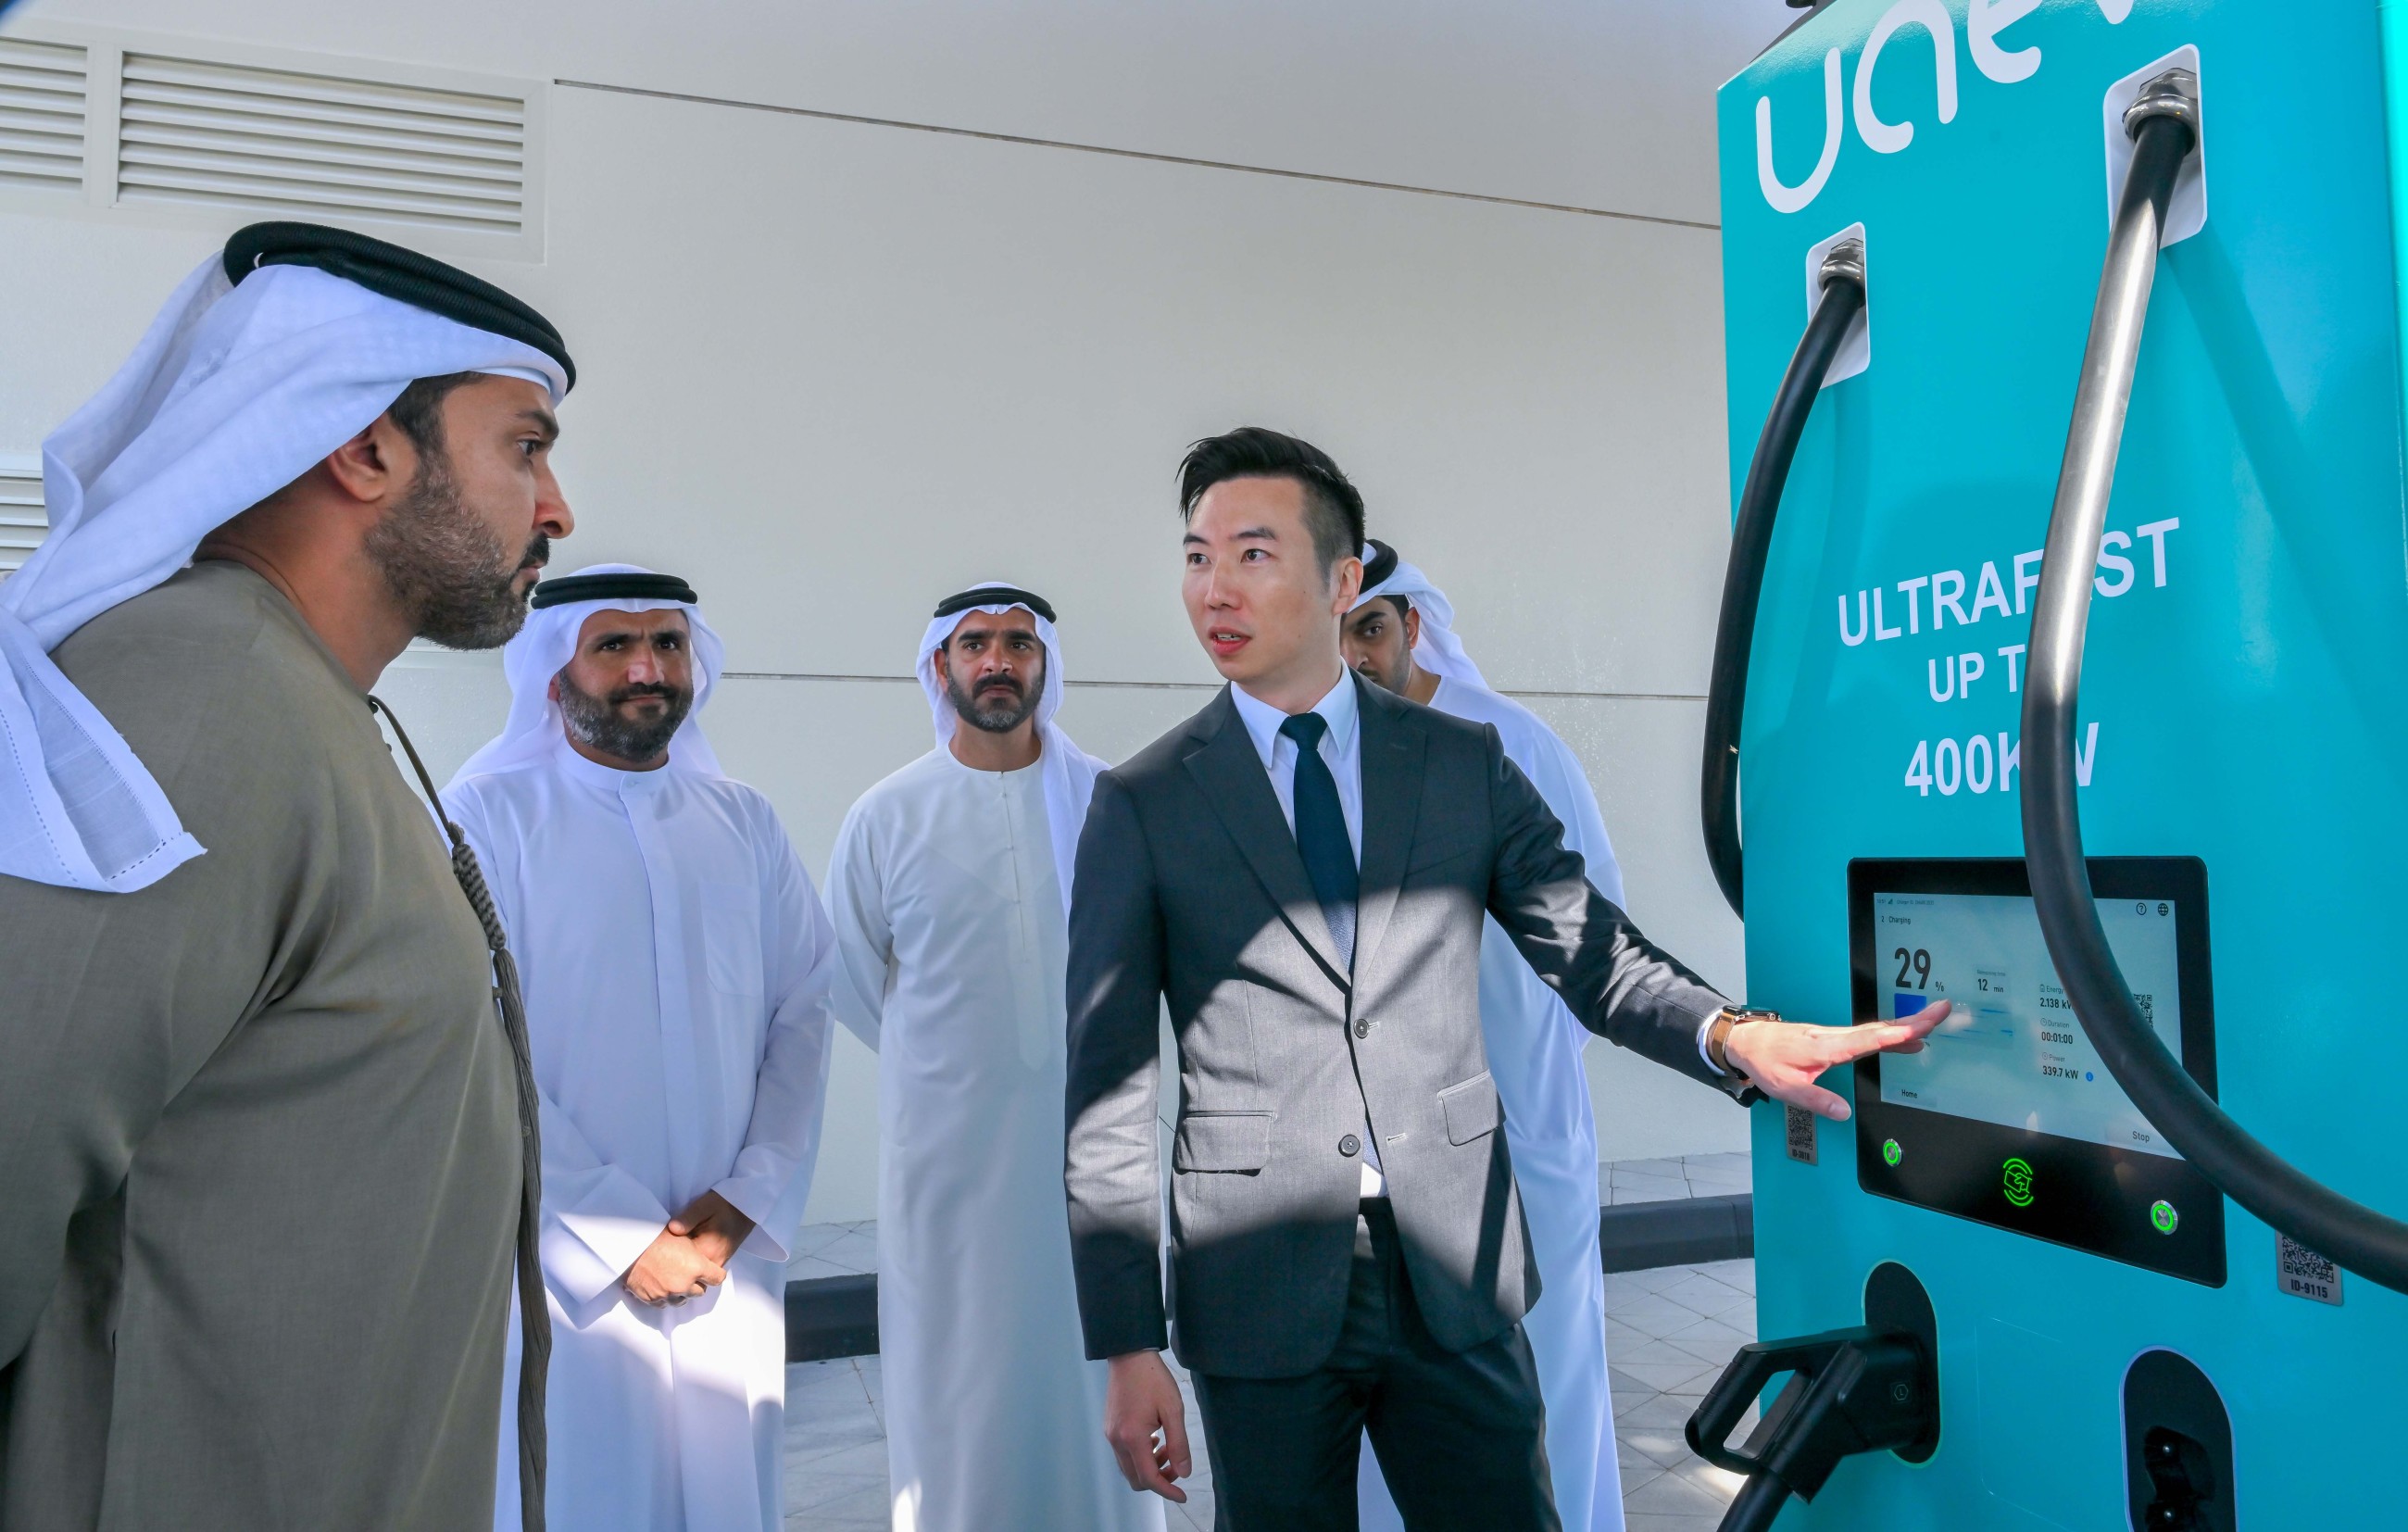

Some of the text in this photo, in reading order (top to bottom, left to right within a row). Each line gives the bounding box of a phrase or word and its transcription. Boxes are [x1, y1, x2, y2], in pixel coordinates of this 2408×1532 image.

[1838, 517, 2179, 647] ULTRAFST
[1928, 644, 2025, 702] UP T
[1888, 916, 1911, 925] Charging
[1894, 947, 1945, 992] 29 %
[1977, 978, 1988, 991] 12
[2039, 997, 2059, 1009] 2.138
[2048, 1019, 2070, 1029] Duration
[2041, 1031, 2074, 1045] 00:01:00
[2049, 1053, 2065, 1062] Power
[2042, 1065, 2079, 1080] 339.7 kW
[1901, 1088, 1918, 1099] Home
[2132, 1130, 2151, 1144] Stop
[2290, 1278, 2328, 1299] ID-9115
